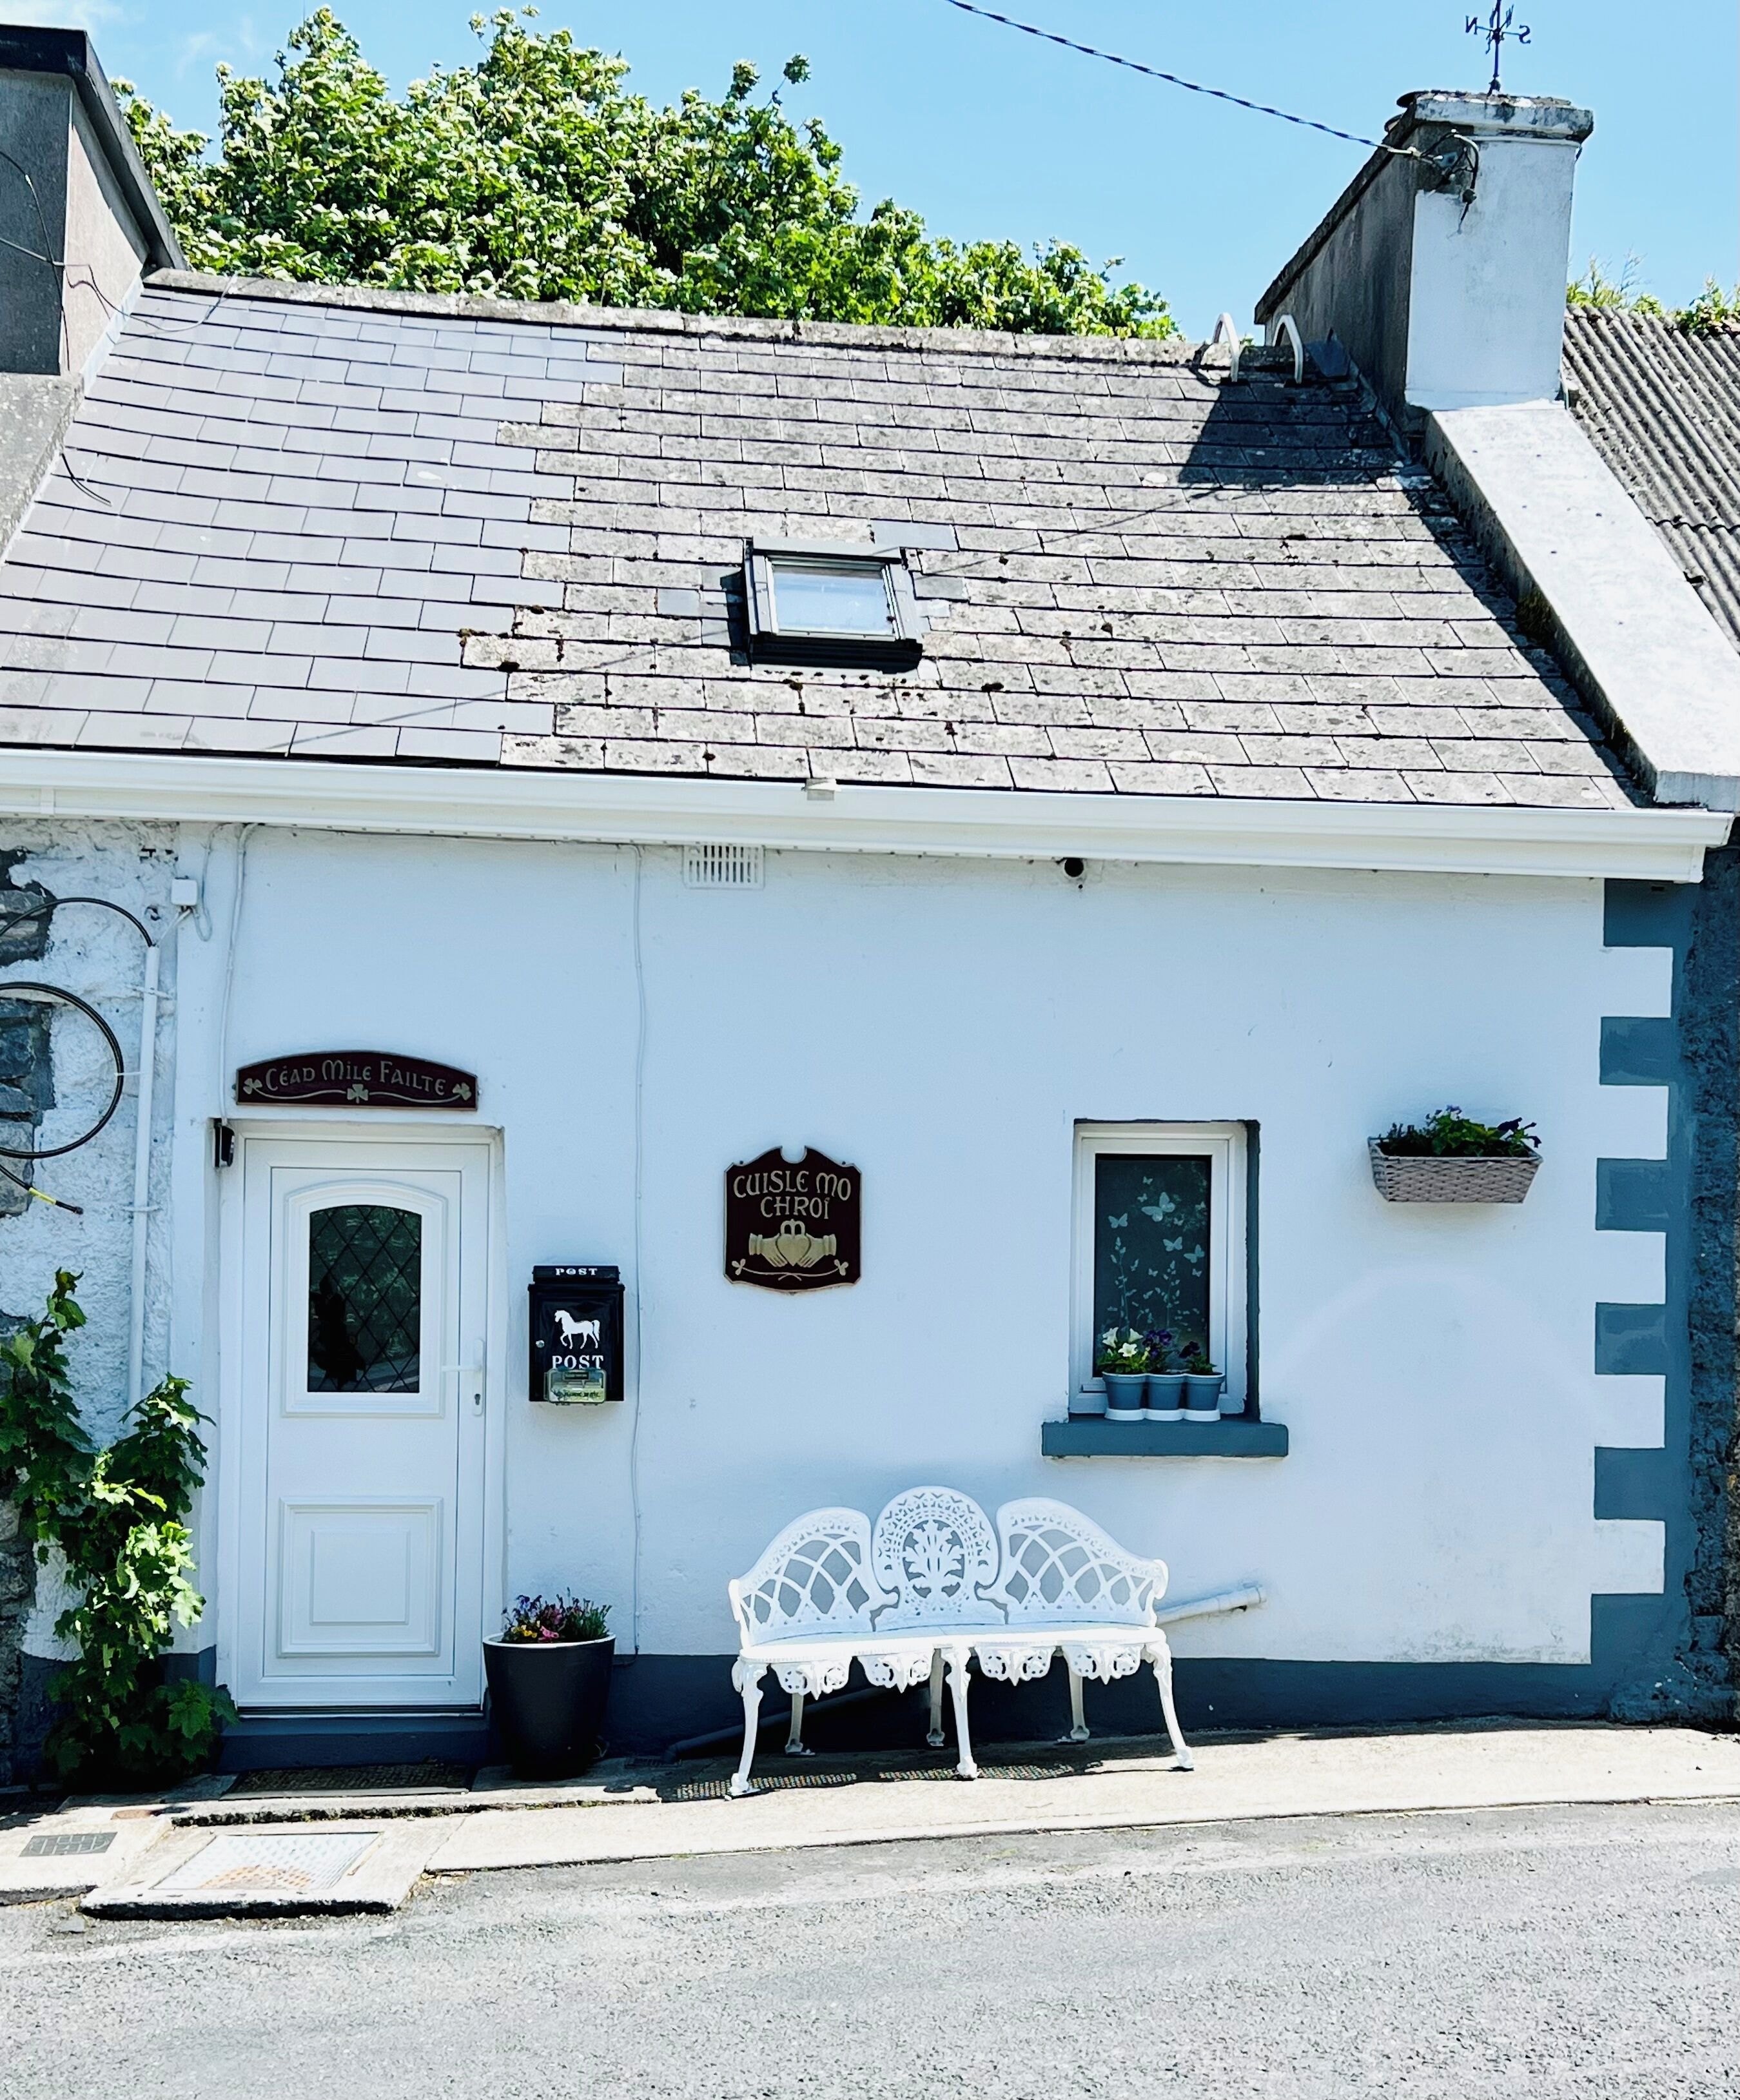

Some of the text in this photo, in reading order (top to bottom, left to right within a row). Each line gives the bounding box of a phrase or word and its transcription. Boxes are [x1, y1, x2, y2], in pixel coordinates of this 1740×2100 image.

[733, 1170, 851, 1201] CUISLE MO
[552, 1355, 603, 1369] POST
